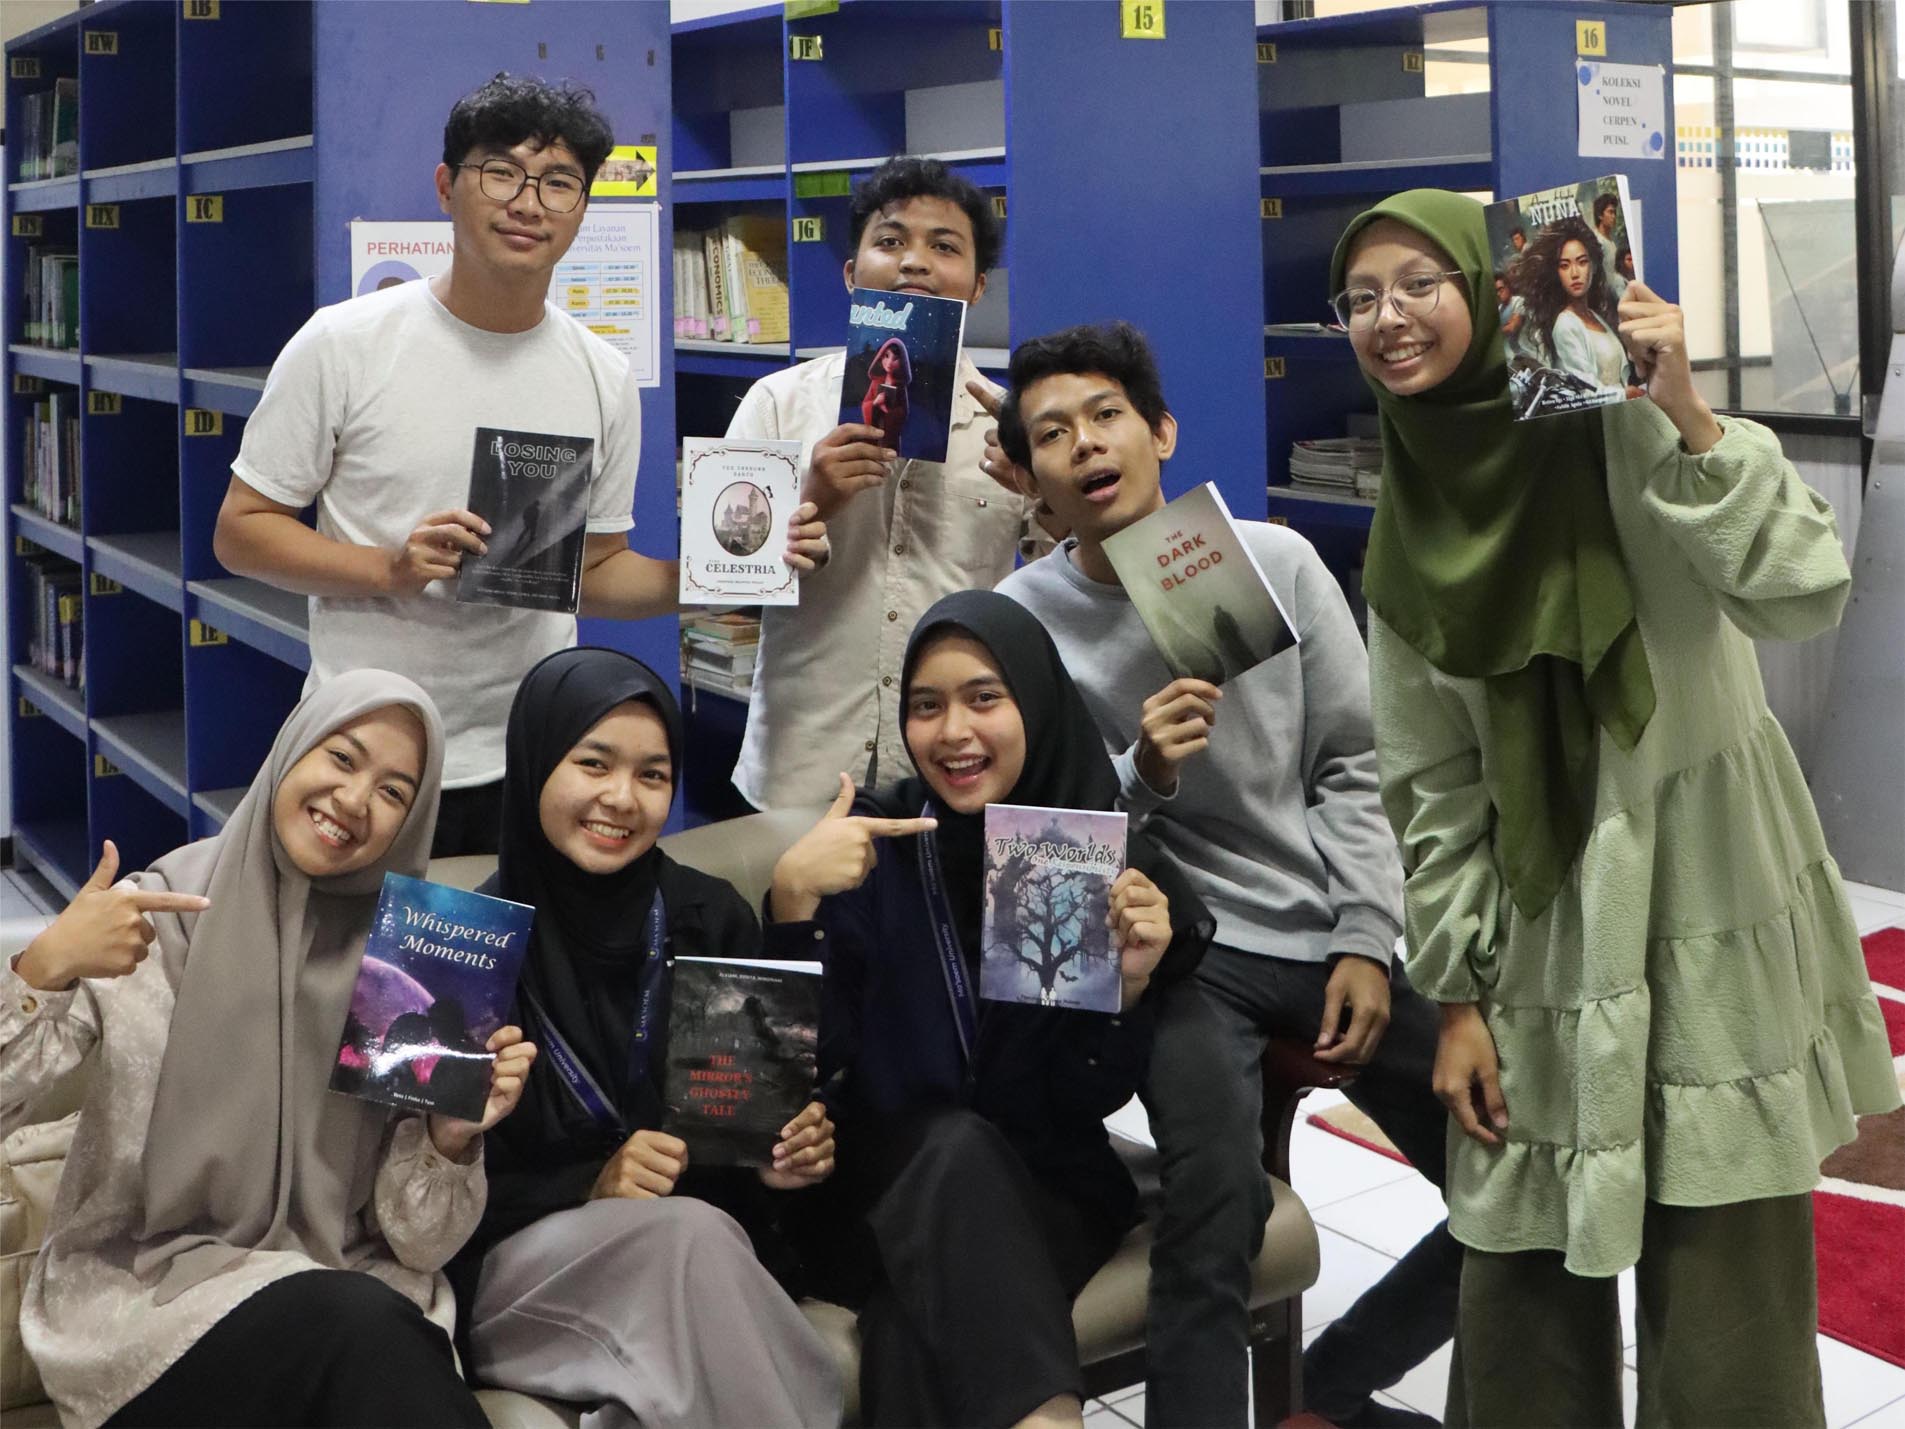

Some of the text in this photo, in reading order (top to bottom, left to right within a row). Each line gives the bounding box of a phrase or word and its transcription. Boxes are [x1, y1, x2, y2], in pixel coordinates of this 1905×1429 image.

[1132, 5, 1153, 30] 15
[88, 34, 114, 52] HW
[797, 38, 812, 58] JF
[1583, 27, 1599, 49] 16
[1602, 75, 1641, 89] KOLEKSI
[1602, 95, 1632, 108] NOVEL
[1602, 114, 1637, 127] CERPEN
[91, 207, 115, 226] HX
[194, 197, 213, 220] IC
[1528, 197, 1581, 227] NUNA
[797, 219, 814, 241] JG
[193, 411, 214, 433] ID
[491, 440, 577, 463] LOSING
[507, 461, 557, 479] YOU
[1165, 529, 1184, 543] THE
[1156, 533, 1207, 569] DARK
[705, 563, 776, 575] CELESTRIA
[1160, 551, 1223, 592] BLOOD
[993, 837, 1117, 865] Two Worlds
[402, 905, 516, 949] Whispered
[399, 934, 497, 970] Moments
[709, 1054, 736, 1066] THE
[703, 1104, 736, 1117] TALE
